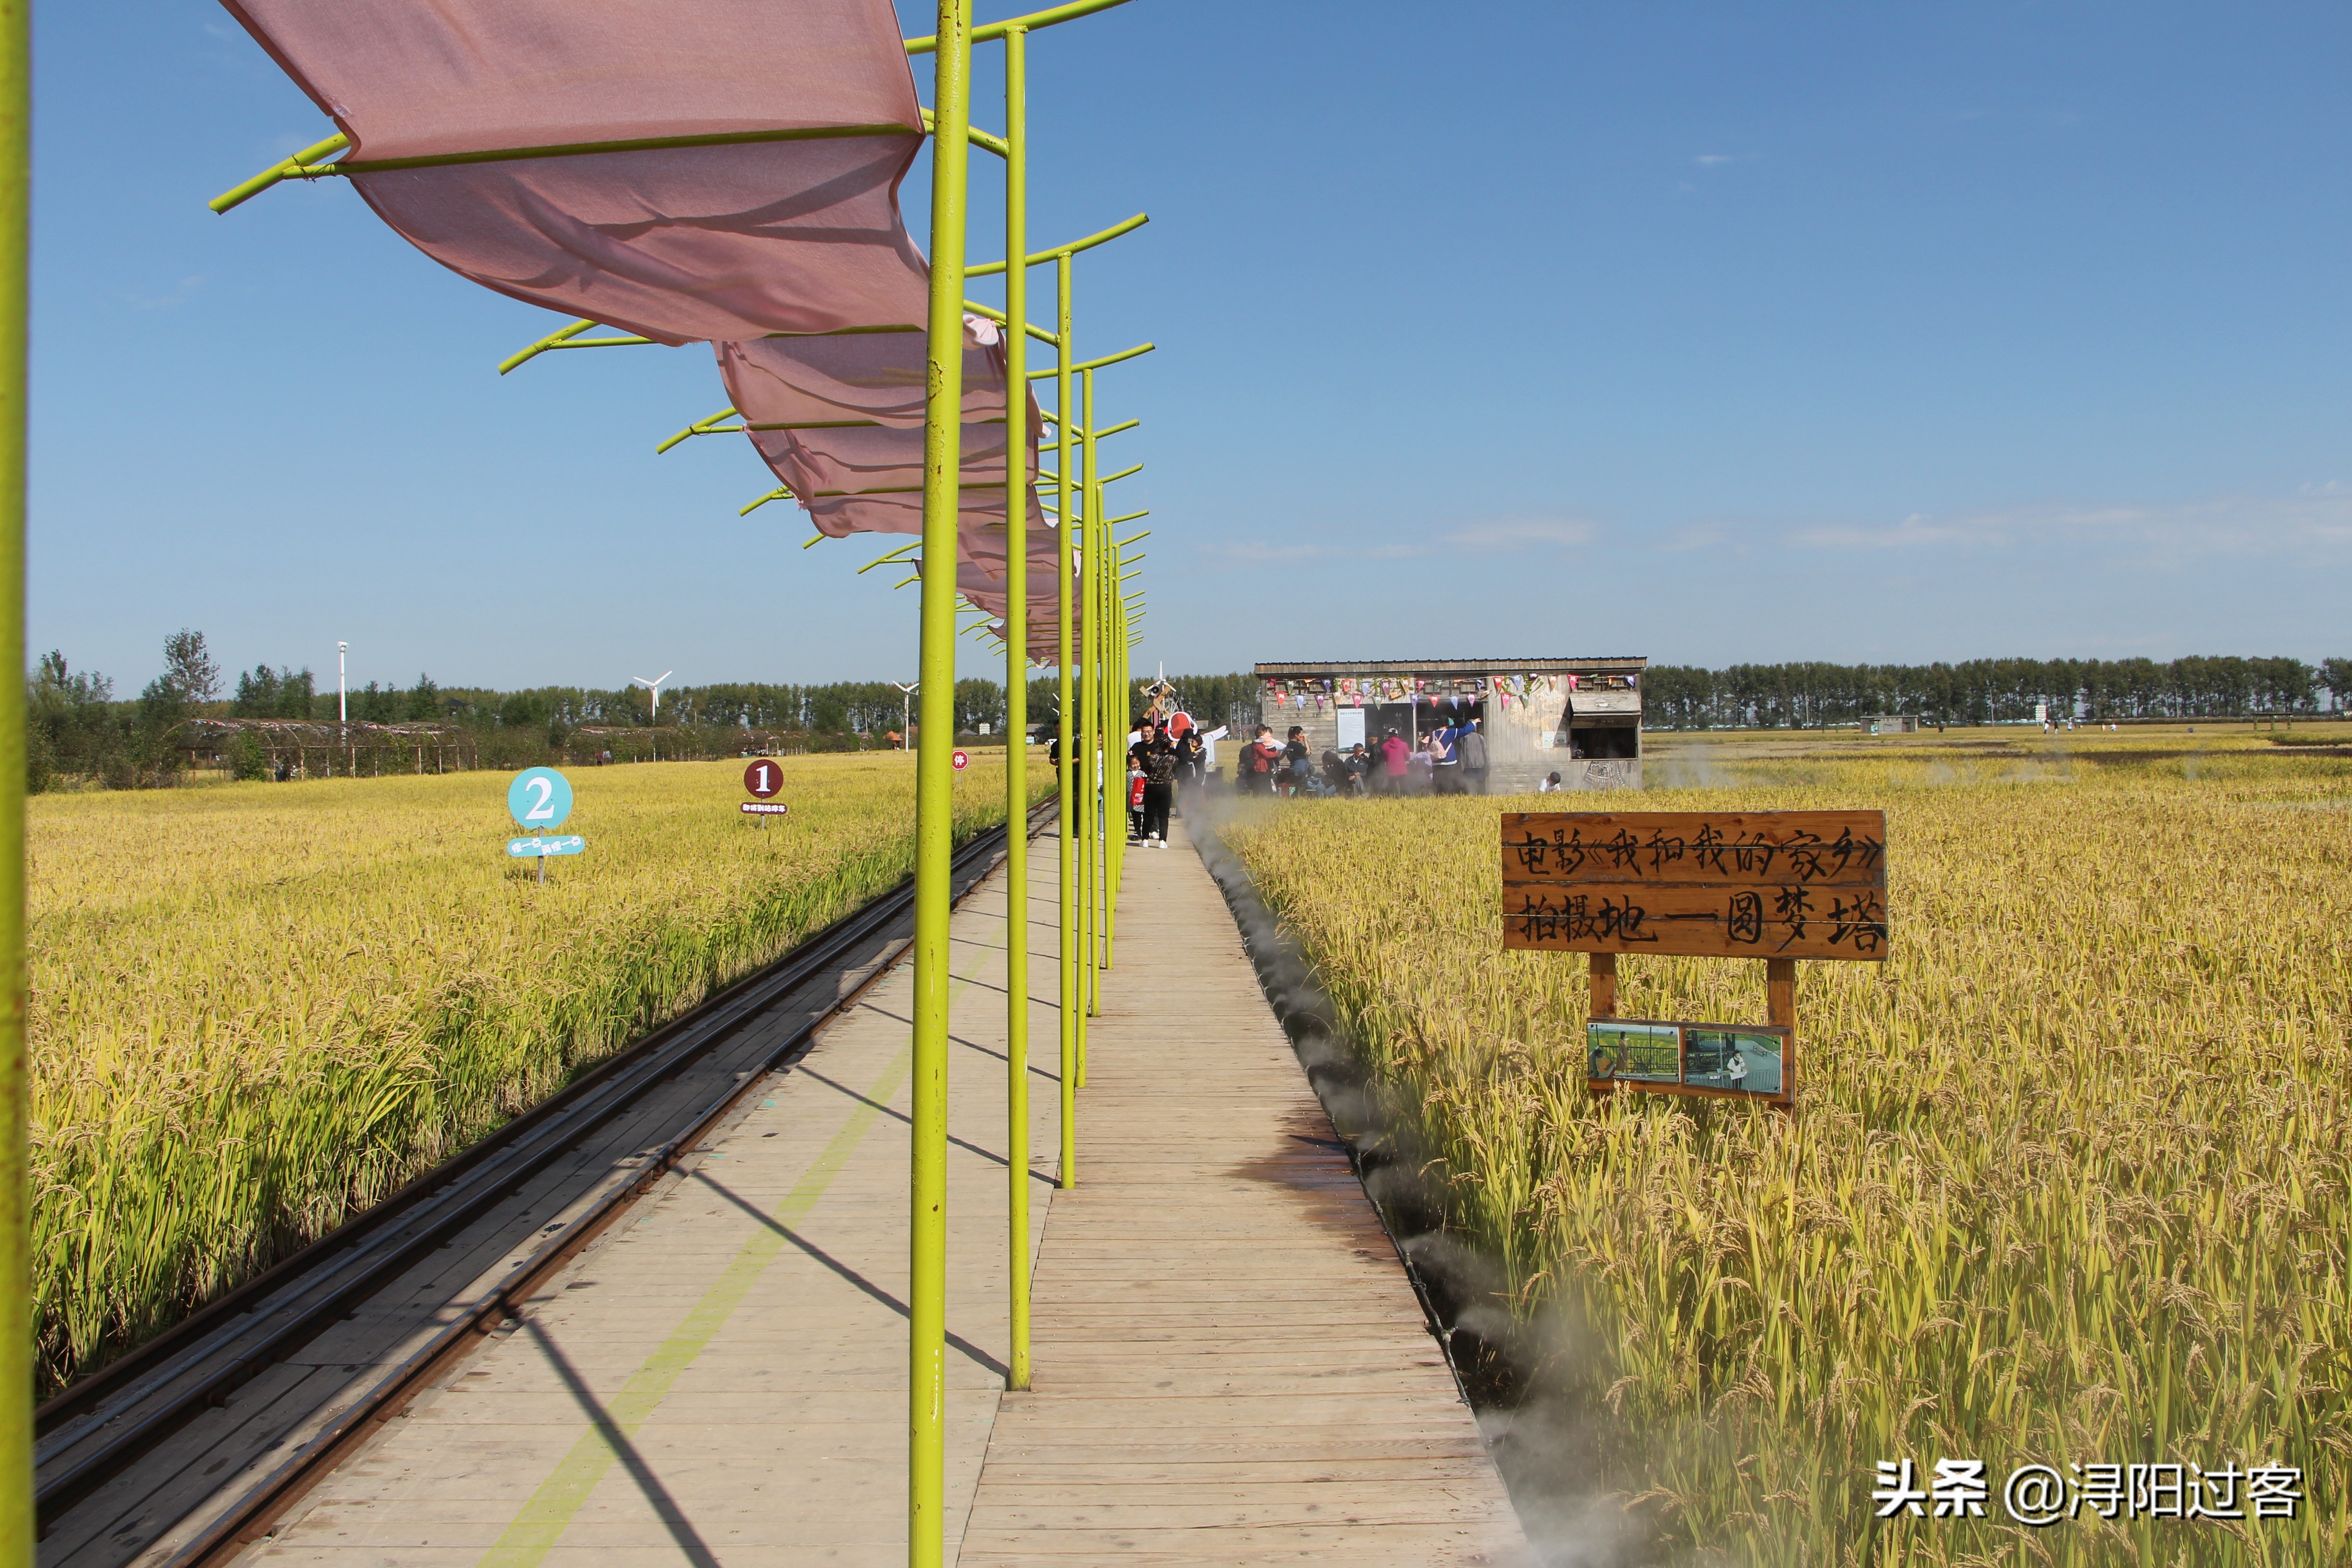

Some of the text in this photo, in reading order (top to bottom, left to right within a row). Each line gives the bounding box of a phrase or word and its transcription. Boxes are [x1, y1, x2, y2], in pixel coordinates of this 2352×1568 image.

[755, 765, 771, 792] 1
[525, 777, 555, 820] 2
[742, 804, 786, 813] 即将到站停车
[1517, 823, 1881, 882] 电影《我和我的家乡》
